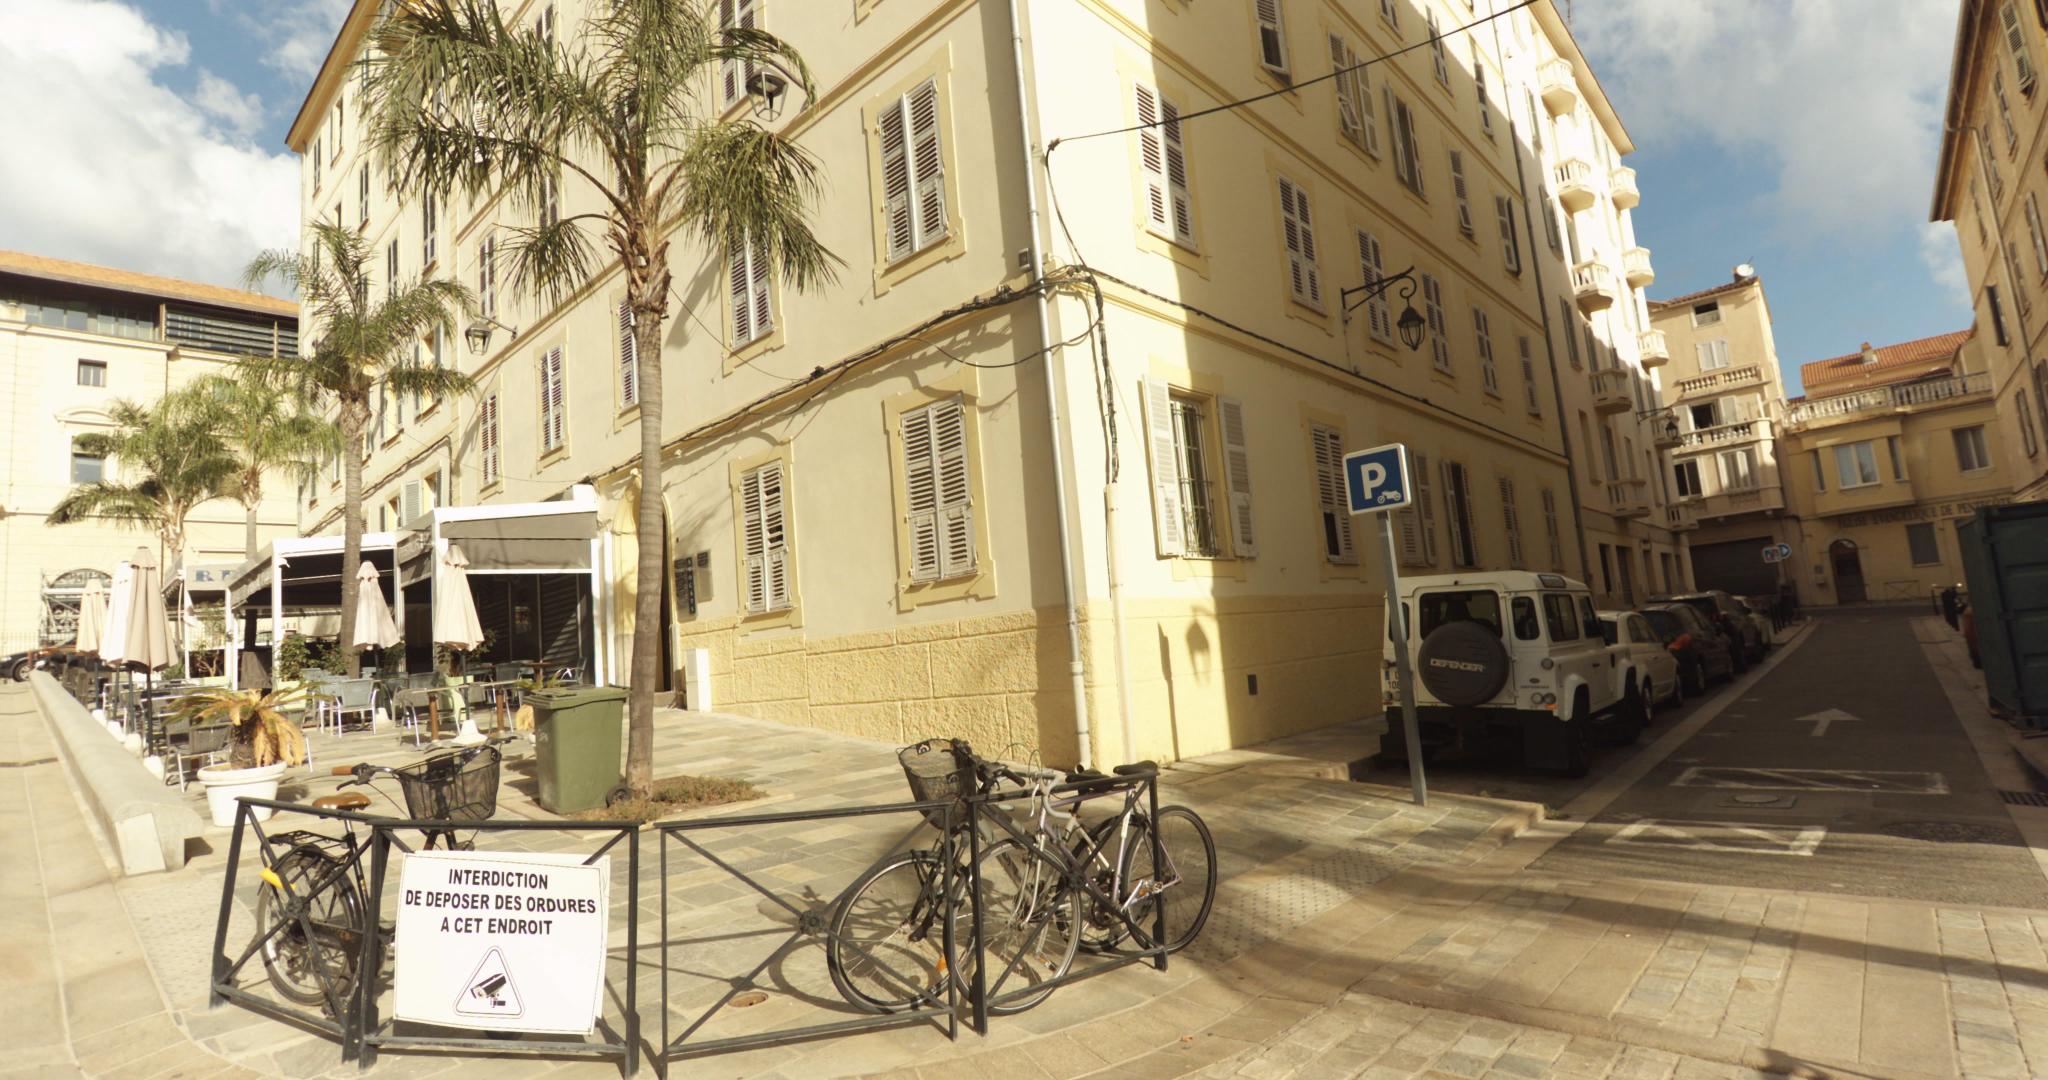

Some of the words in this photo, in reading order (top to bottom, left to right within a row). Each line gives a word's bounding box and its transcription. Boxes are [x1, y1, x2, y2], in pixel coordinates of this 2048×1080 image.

[1360, 462, 1387, 500] P
[1430, 657, 1485, 672] DEFENDER
[449, 869, 548, 889] INTERDICTION
[405, 890, 422, 906] DE
[425, 891, 490, 909] DEPOSER
[494, 895, 522, 911] DES
[526, 897, 596, 913] ORDURES
[440, 917, 449, 932] A
[454, 918, 483, 933] CET
[488, 918, 552, 935] ENDROIT
